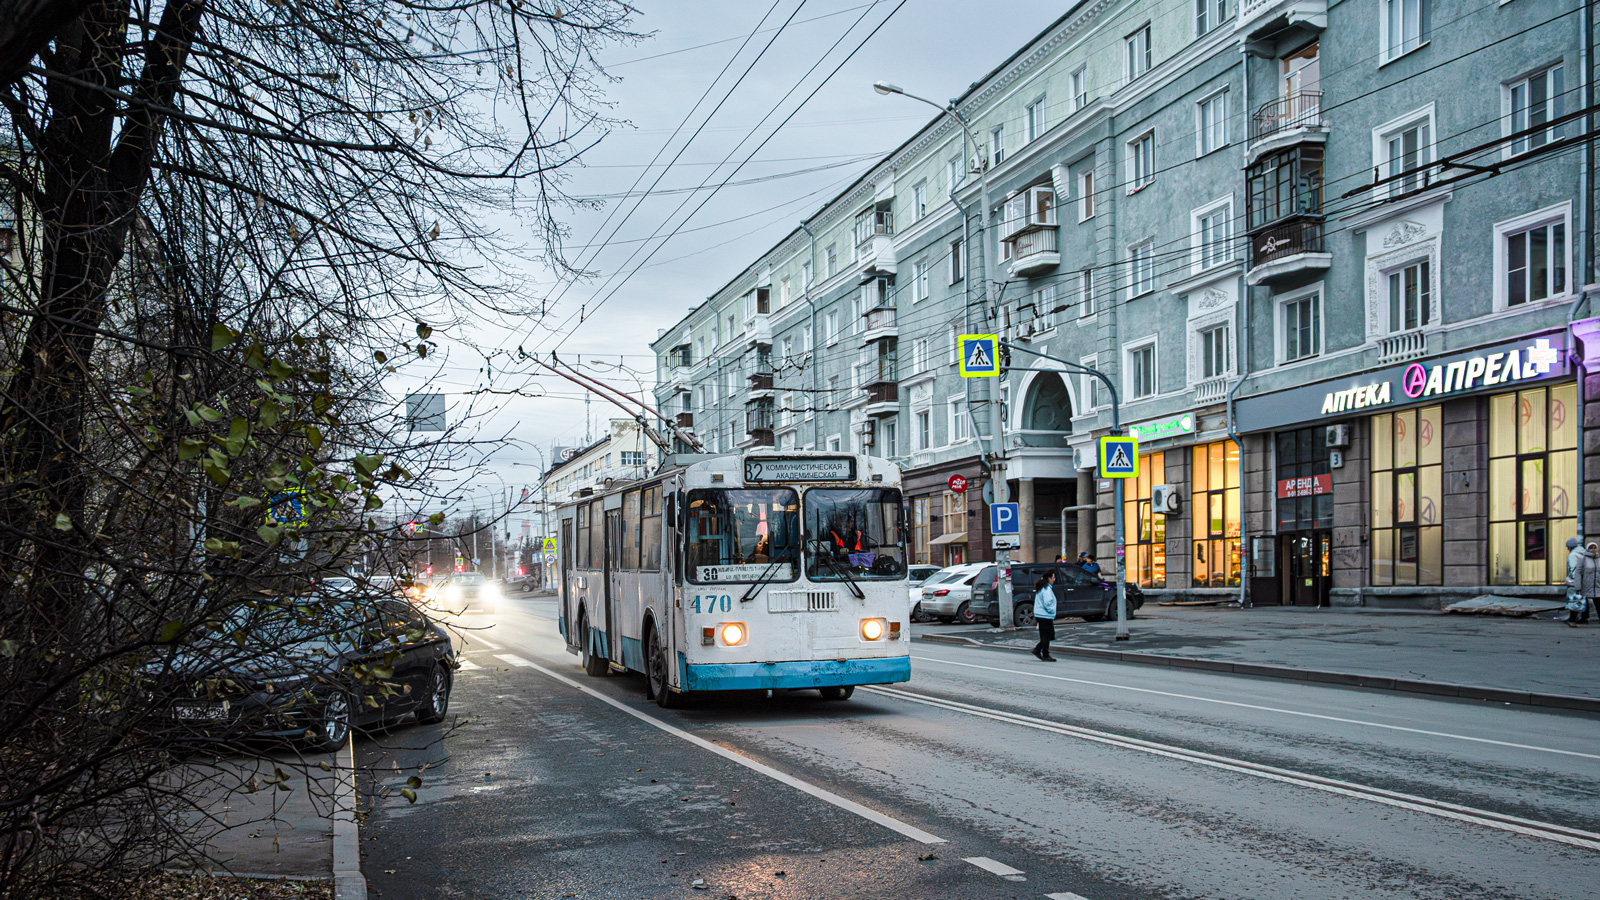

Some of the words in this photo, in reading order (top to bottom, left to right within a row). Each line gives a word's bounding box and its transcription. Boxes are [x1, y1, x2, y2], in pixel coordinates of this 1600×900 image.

[1321, 381, 1391, 414] АПТЕКА
[1333, 453, 1339, 465] 3
[765, 463, 843, 471] КОММУНИСТИЧЕСКАЯ
[776, 471, 837, 479] АКАДЕМИЧЕСКАЯ
[1285, 476, 1320, 490] АРЕНДА
[996, 506, 1012, 531] P
[703, 567, 718, 581] 30
[690, 594, 732, 614] 470
